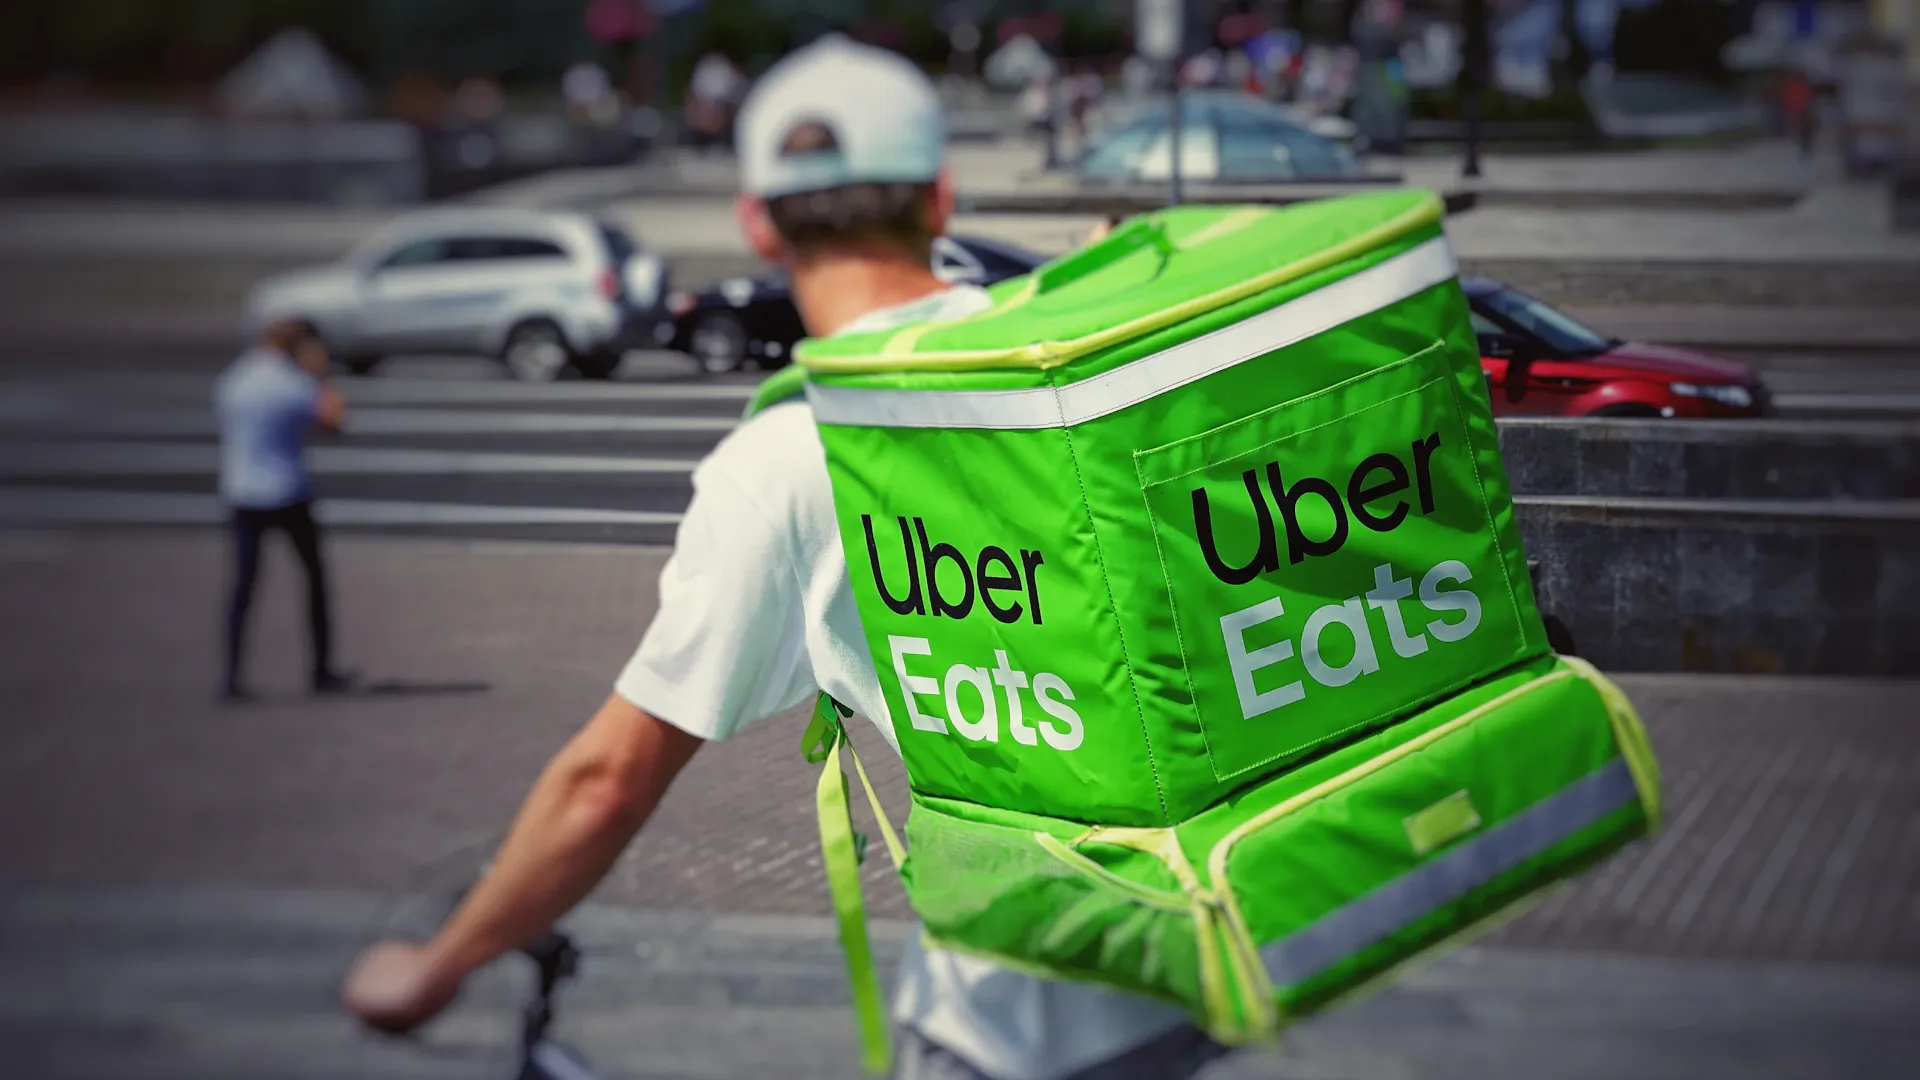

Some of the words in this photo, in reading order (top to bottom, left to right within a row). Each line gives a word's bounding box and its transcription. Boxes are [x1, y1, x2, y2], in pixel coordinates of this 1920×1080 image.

[862, 514, 1044, 625] Uber
[1191, 432, 1441, 585] Uber
[887, 634, 1085, 751] Eats
[1219, 560, 1483, 720] Eats
